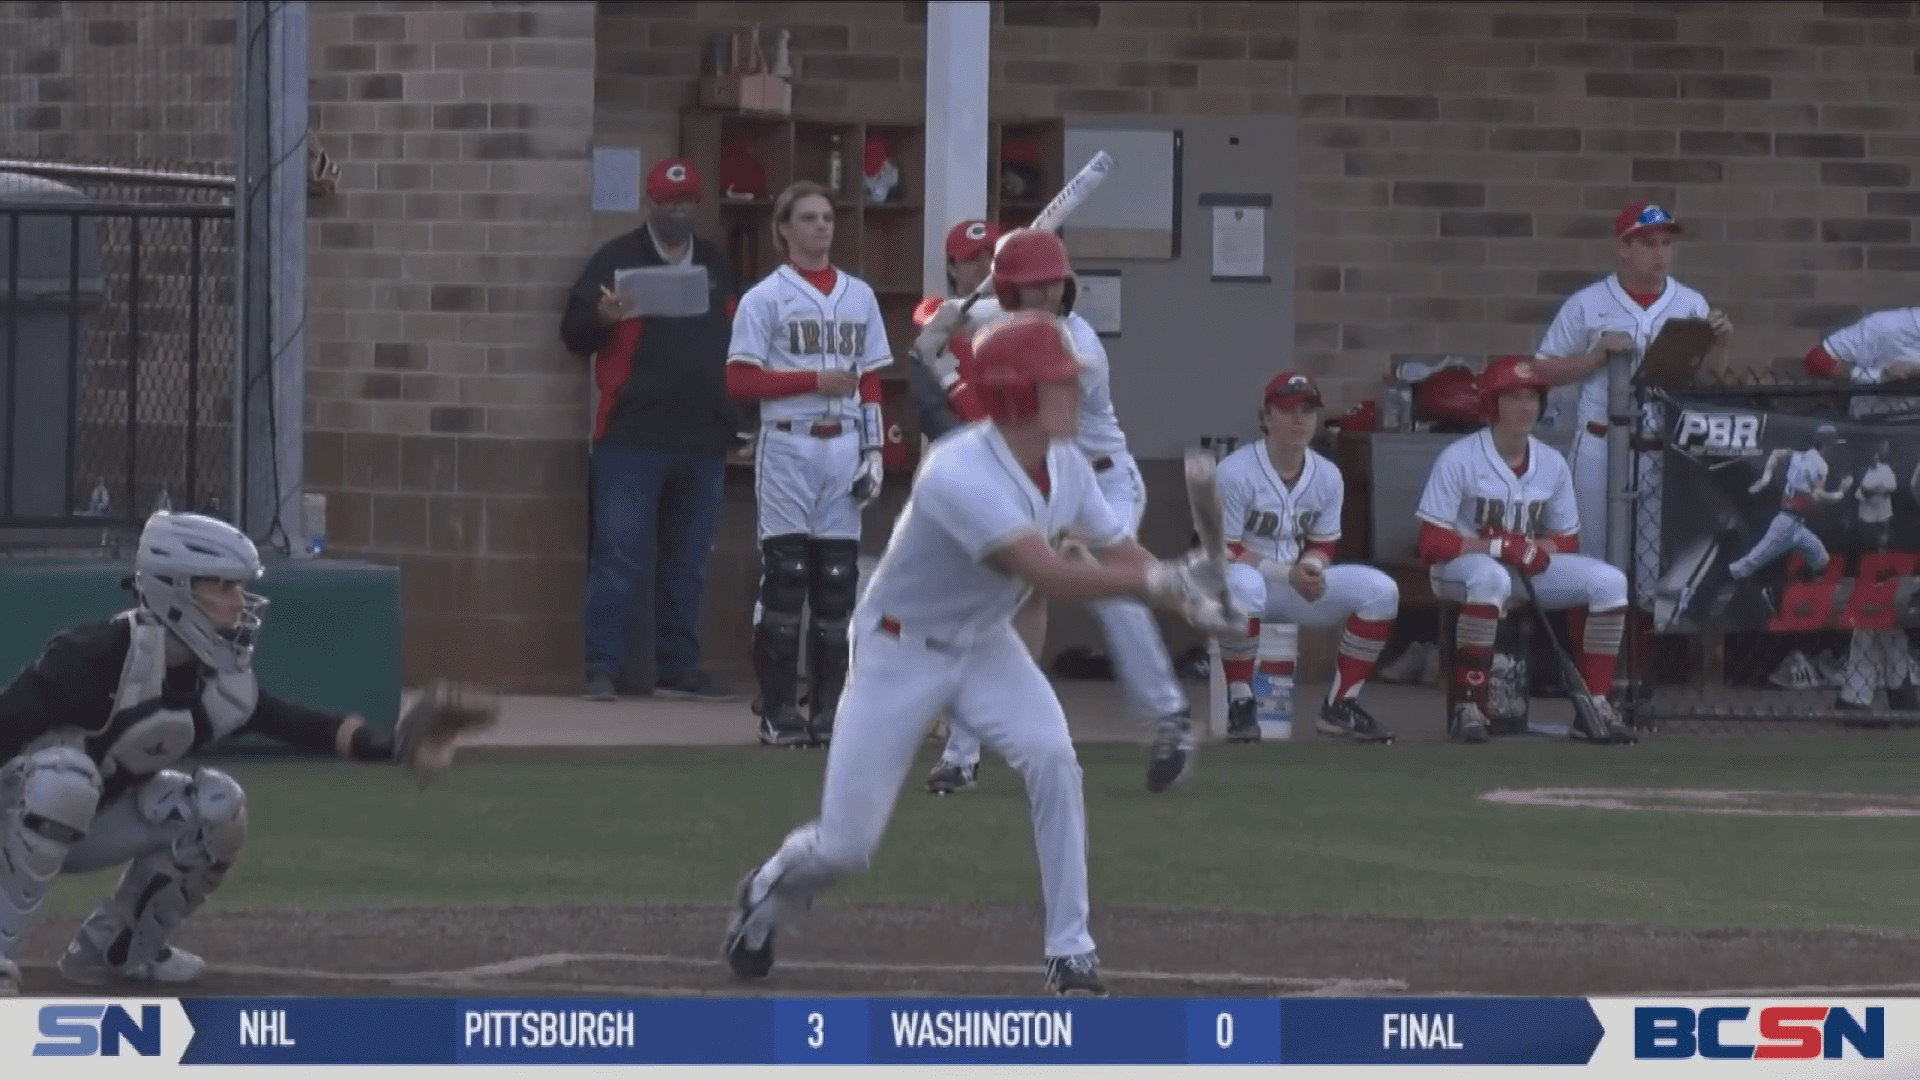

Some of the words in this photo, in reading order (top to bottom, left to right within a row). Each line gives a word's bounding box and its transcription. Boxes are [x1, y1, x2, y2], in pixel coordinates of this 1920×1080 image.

[666, 165, 686, 182] C
[966, 222, 986, 240] C
[1678, 411, 1758, 447] PBR
